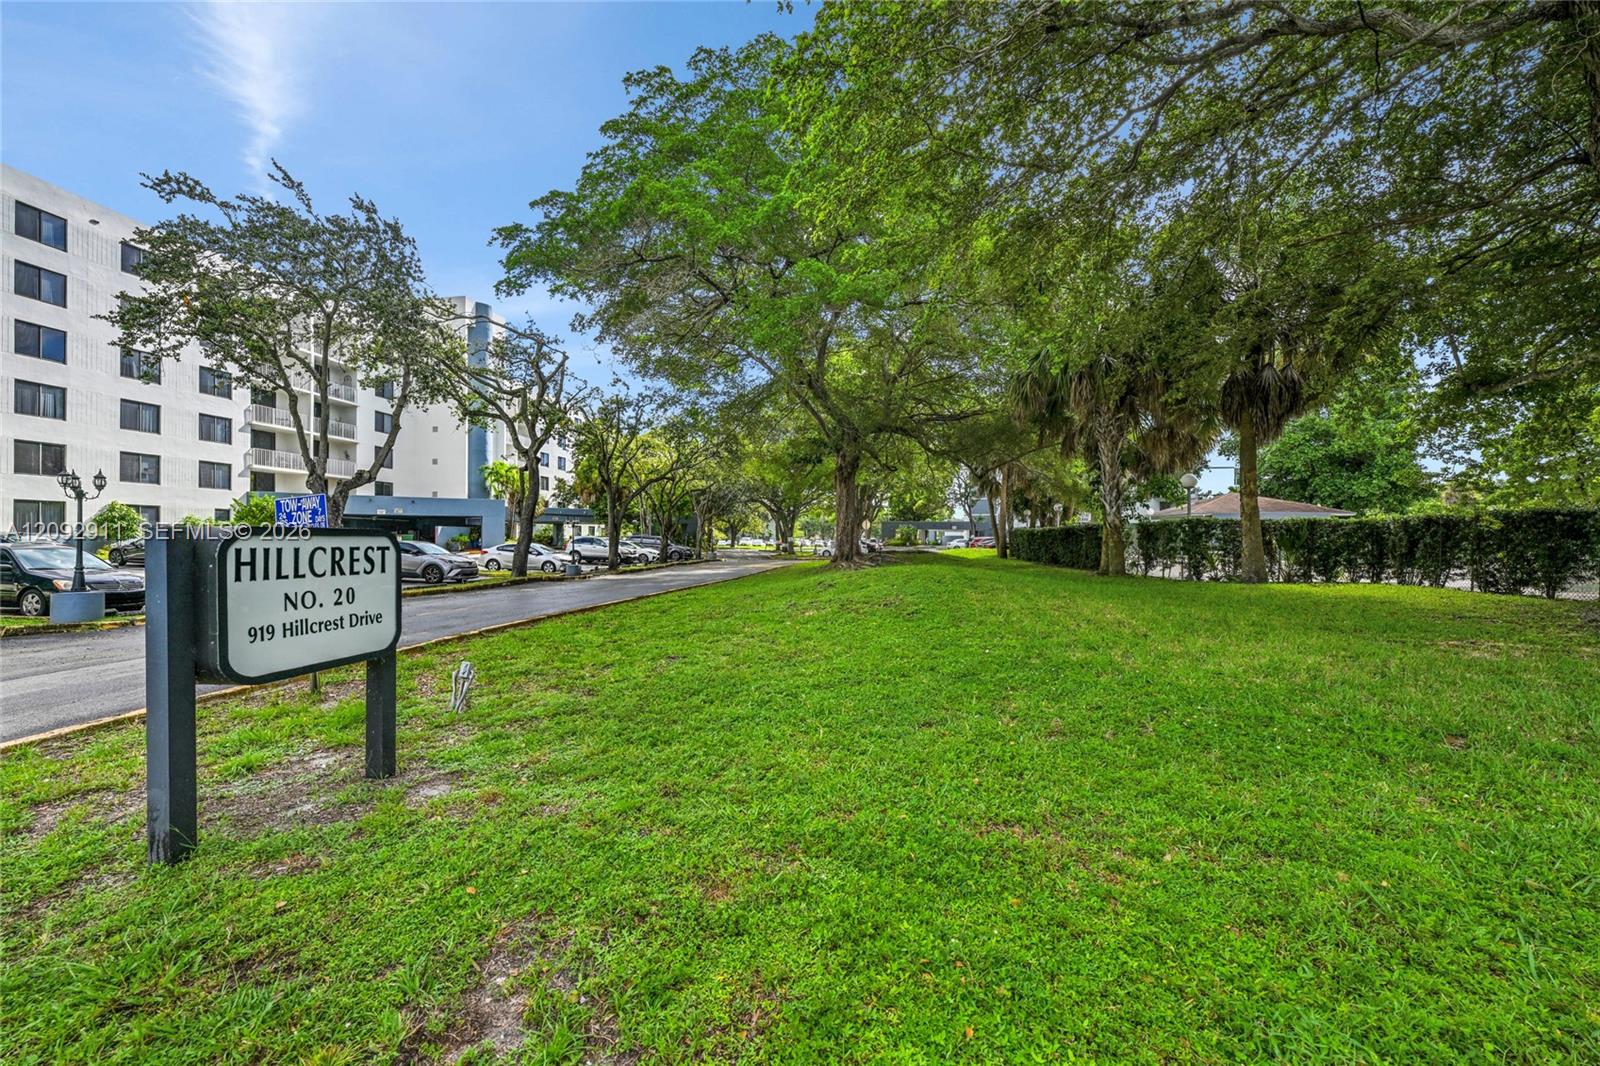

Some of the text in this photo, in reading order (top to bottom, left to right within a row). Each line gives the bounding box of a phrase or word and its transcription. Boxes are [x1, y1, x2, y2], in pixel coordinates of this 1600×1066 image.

[280, 496, 320, 512] TOW-AWAY
[291, 510, 312, 524] ZONE
[234, 546, 390, 582] HILLCREST
[284, 587, 356, 612] NO. 20
[247, 610, 383, 644] 919 Hillcrest Drive
